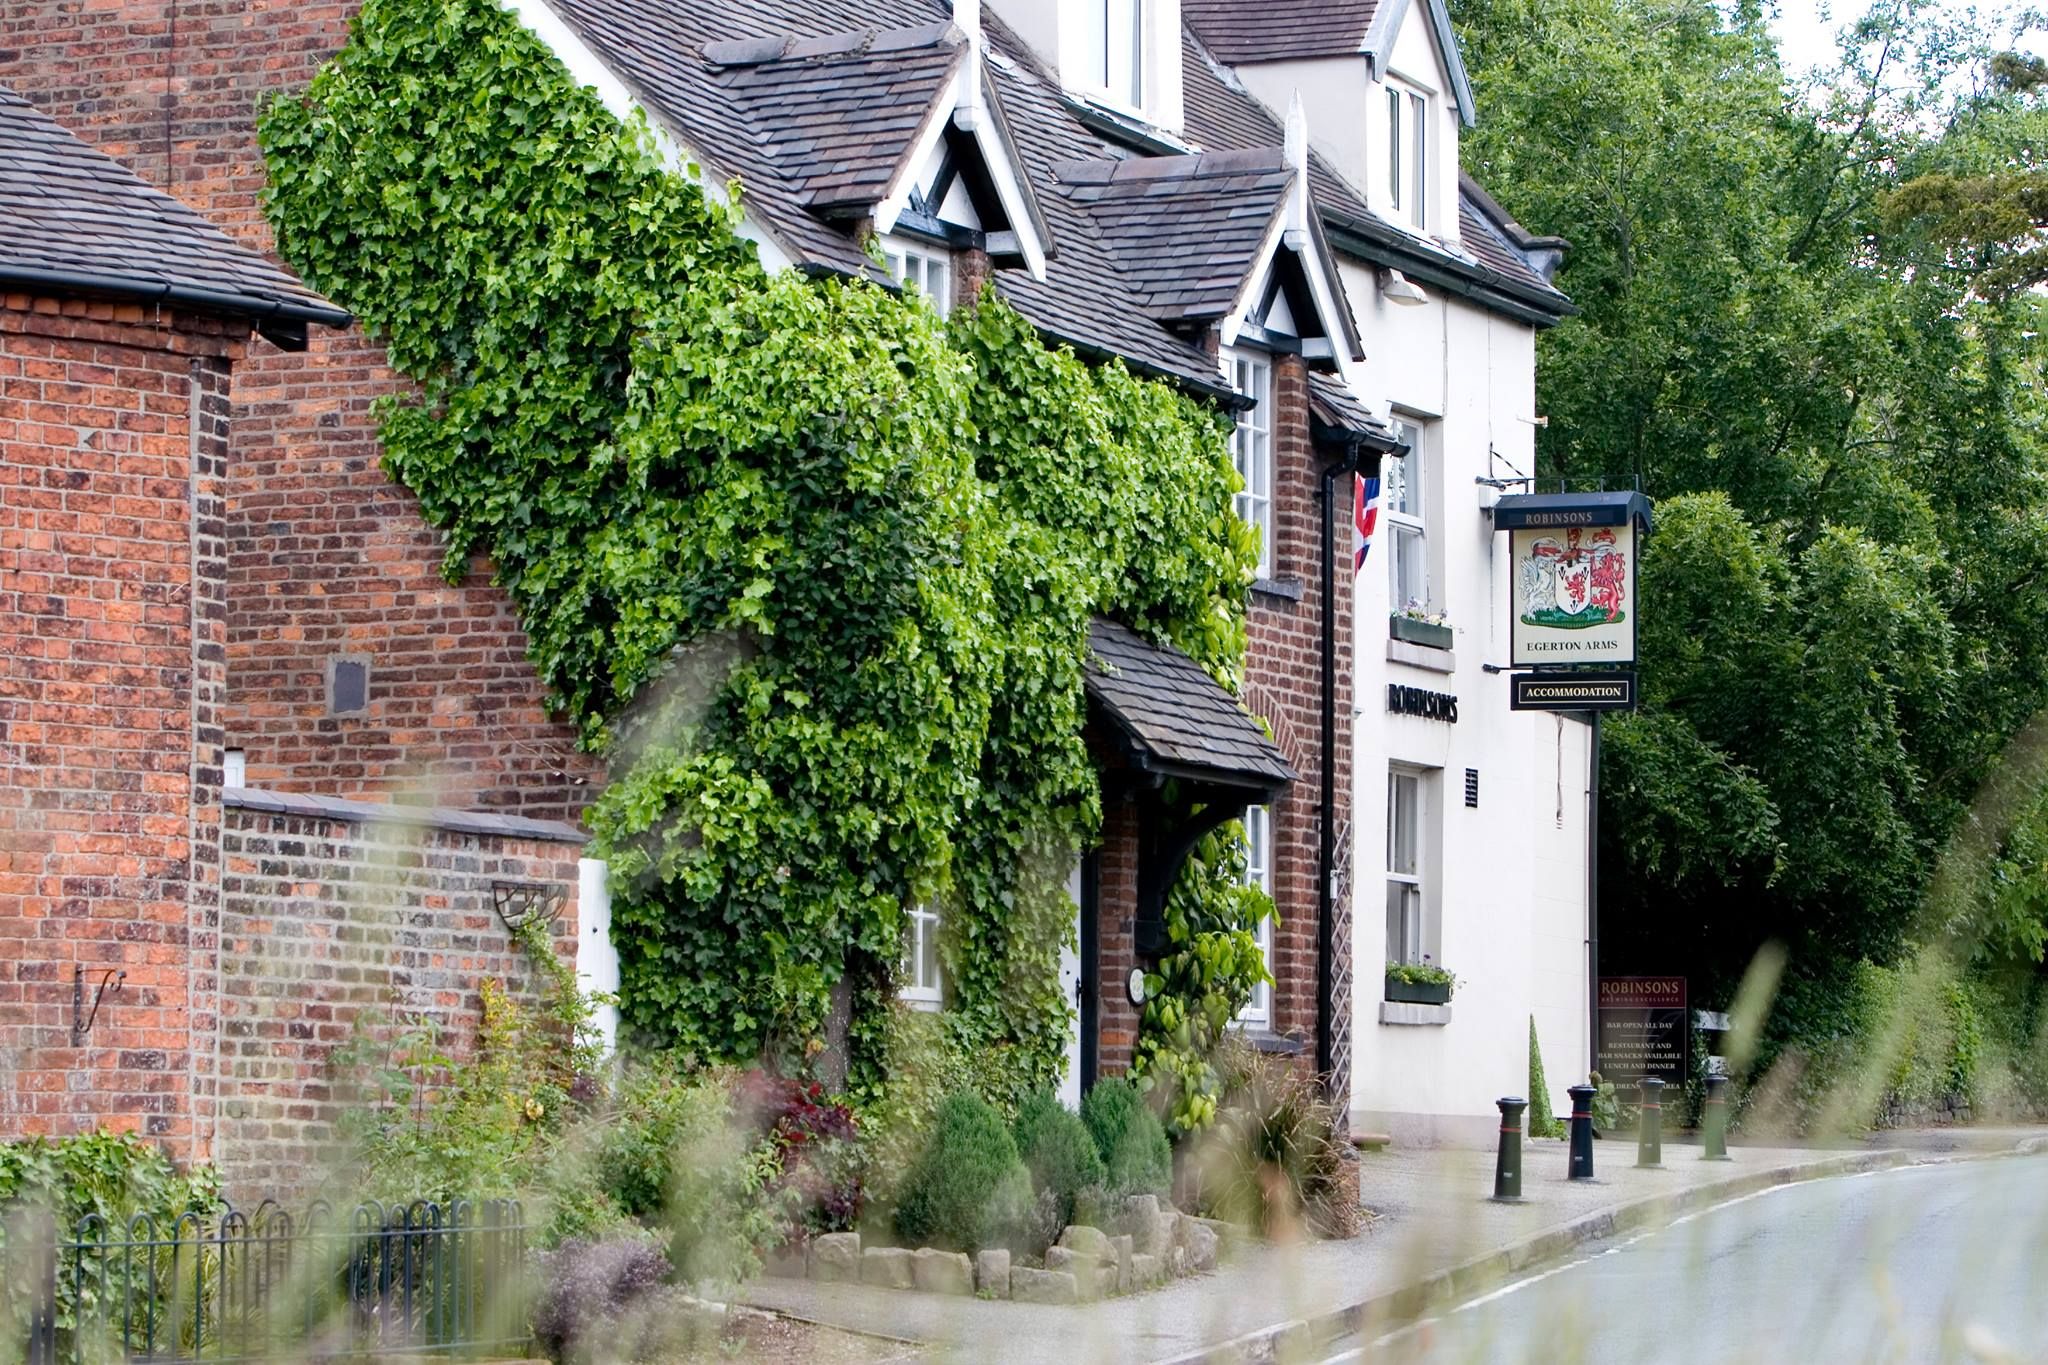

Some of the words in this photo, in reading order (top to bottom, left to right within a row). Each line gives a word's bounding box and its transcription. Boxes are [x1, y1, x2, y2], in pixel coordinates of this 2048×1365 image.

[1526, 512, 1592, 525] ROBINSONS
[1527, 641, 1581, 652] EGERTON
[1585, 640, 1618, 651] ARMS
[1526, 686, 1621, 698] ACCOMMODATION
[1388, 683, 1458, 723] ROBINSONS
[1601, 981, 1679, 994] ROBINSONS
